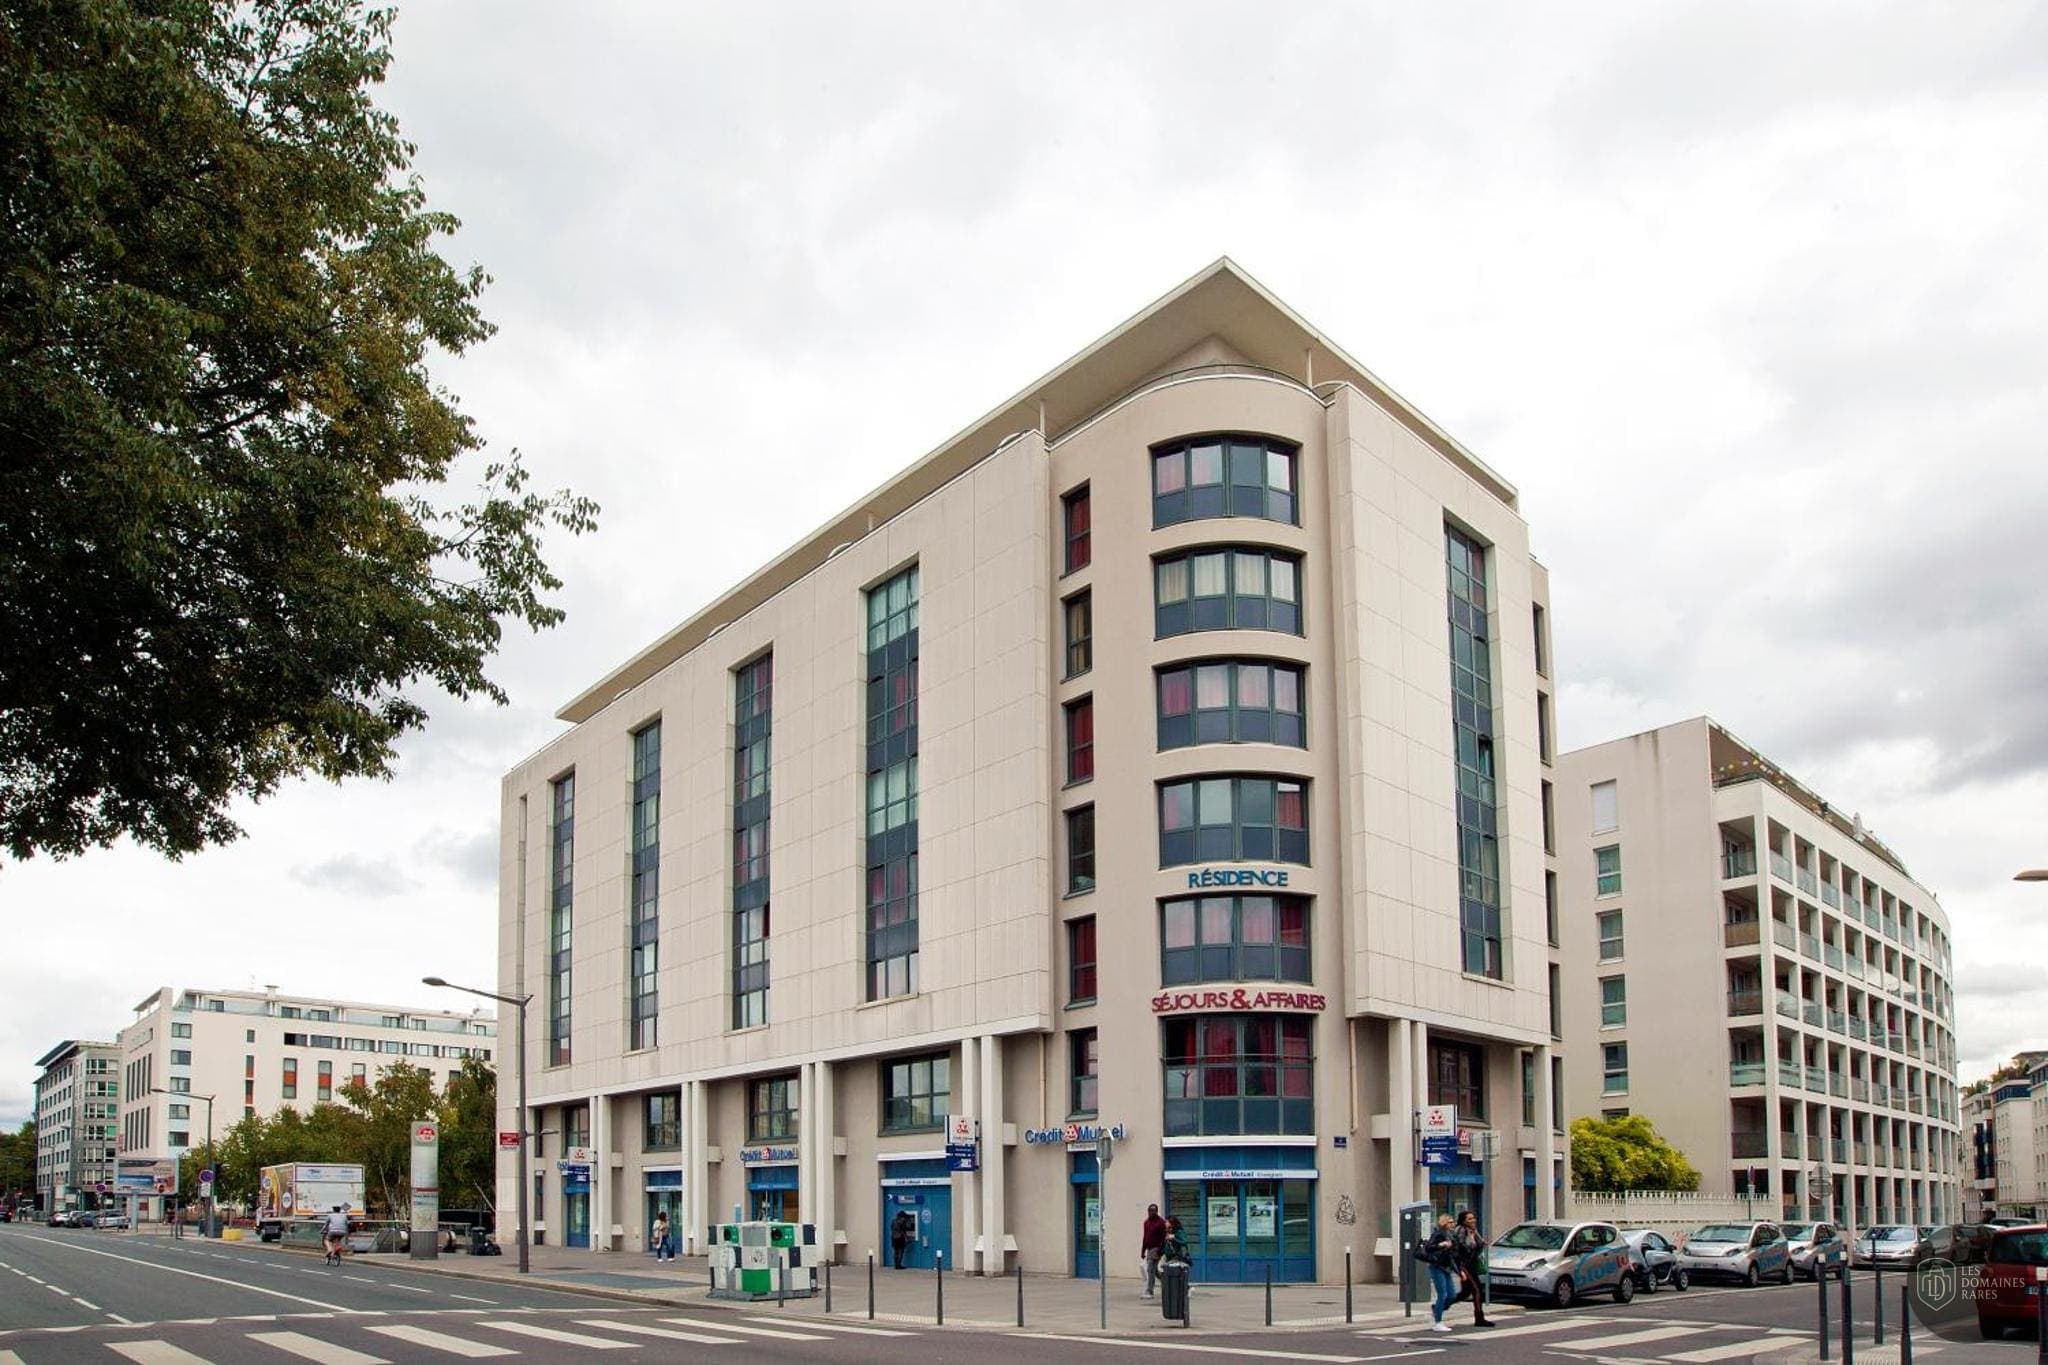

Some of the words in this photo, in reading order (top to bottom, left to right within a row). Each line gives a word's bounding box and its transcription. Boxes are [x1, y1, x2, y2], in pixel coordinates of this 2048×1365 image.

[1188, 868, 1288, 888] RÉSIDENCE
[1152, 992, 1228, 1013] SÉJOURS
[1230, 988, 1252, 1010] &
[1253, 992, 1326, 1011] AFFAIRES
[1025, 1127, 1063, 1144] Crédit
[1078, 1123, 1123, 1141] Muel
